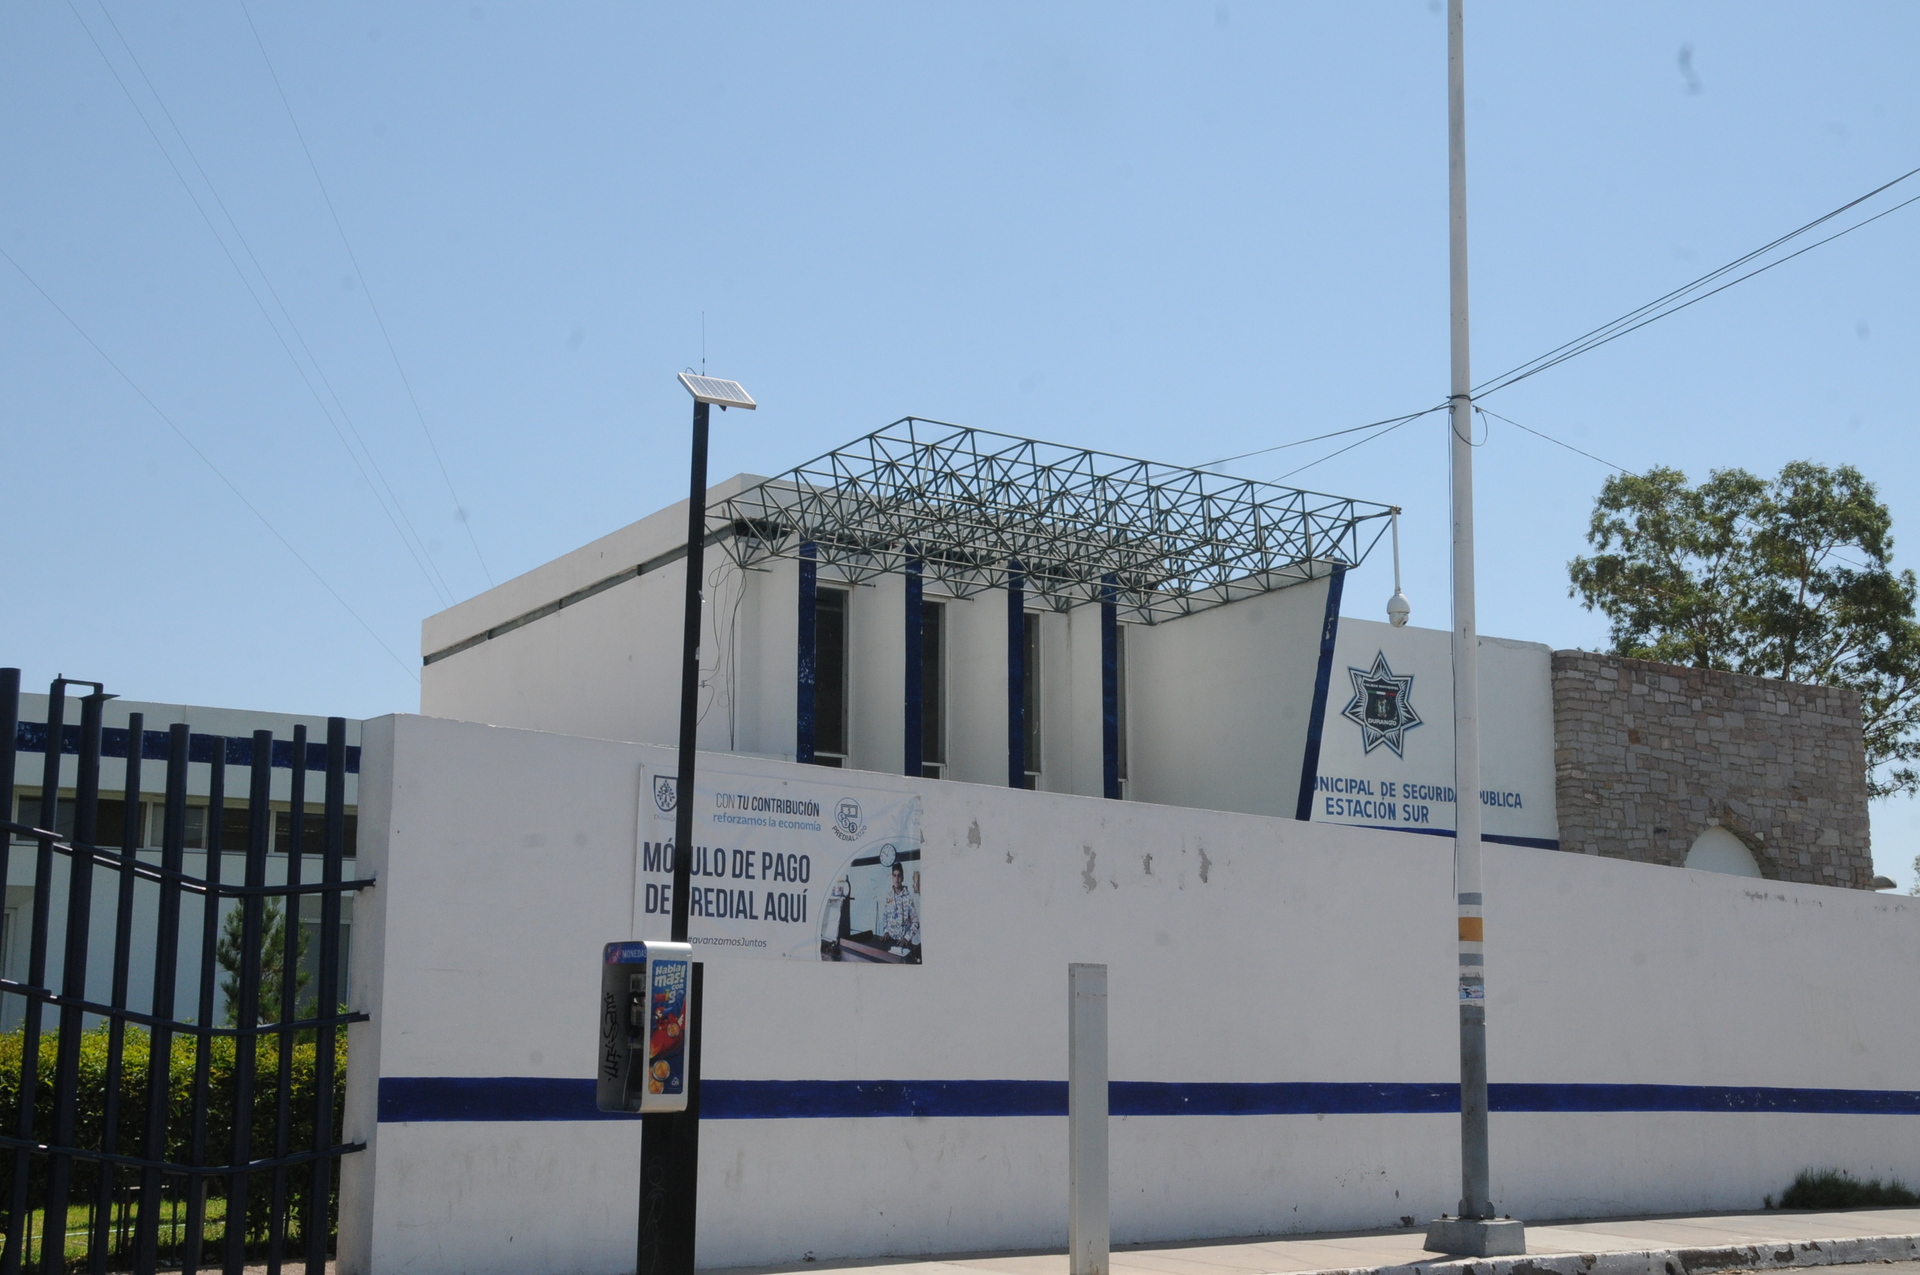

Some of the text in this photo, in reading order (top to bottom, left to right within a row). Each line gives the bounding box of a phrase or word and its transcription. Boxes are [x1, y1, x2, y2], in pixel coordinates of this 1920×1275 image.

[1367, 718, 1397, 726] DURANGO
[1314, 776, 1374, 796] NICIPAL
[1380, 781, 1396, 798] DE
[1403, 783, 1457, 803] SEGURID
[716, 792, 820, 817] CON TU CONTRIBUCIÓN
[1325, 796, 1429, 824] ESTACIÓN SUR
[713, 812, 821, 832] reforzamos la economía
[643, 838, 811, 884] MÓULO DE PAGO
[645, 883, 808, 923] DE REDIAL AQUÍ
[687, 935, 768, 948] #avanzamosJuntos
[621, 949, 647, 958] MONEDAS
[655, 963, 681, 976] Habla
[671, 983, 684, 991] con
